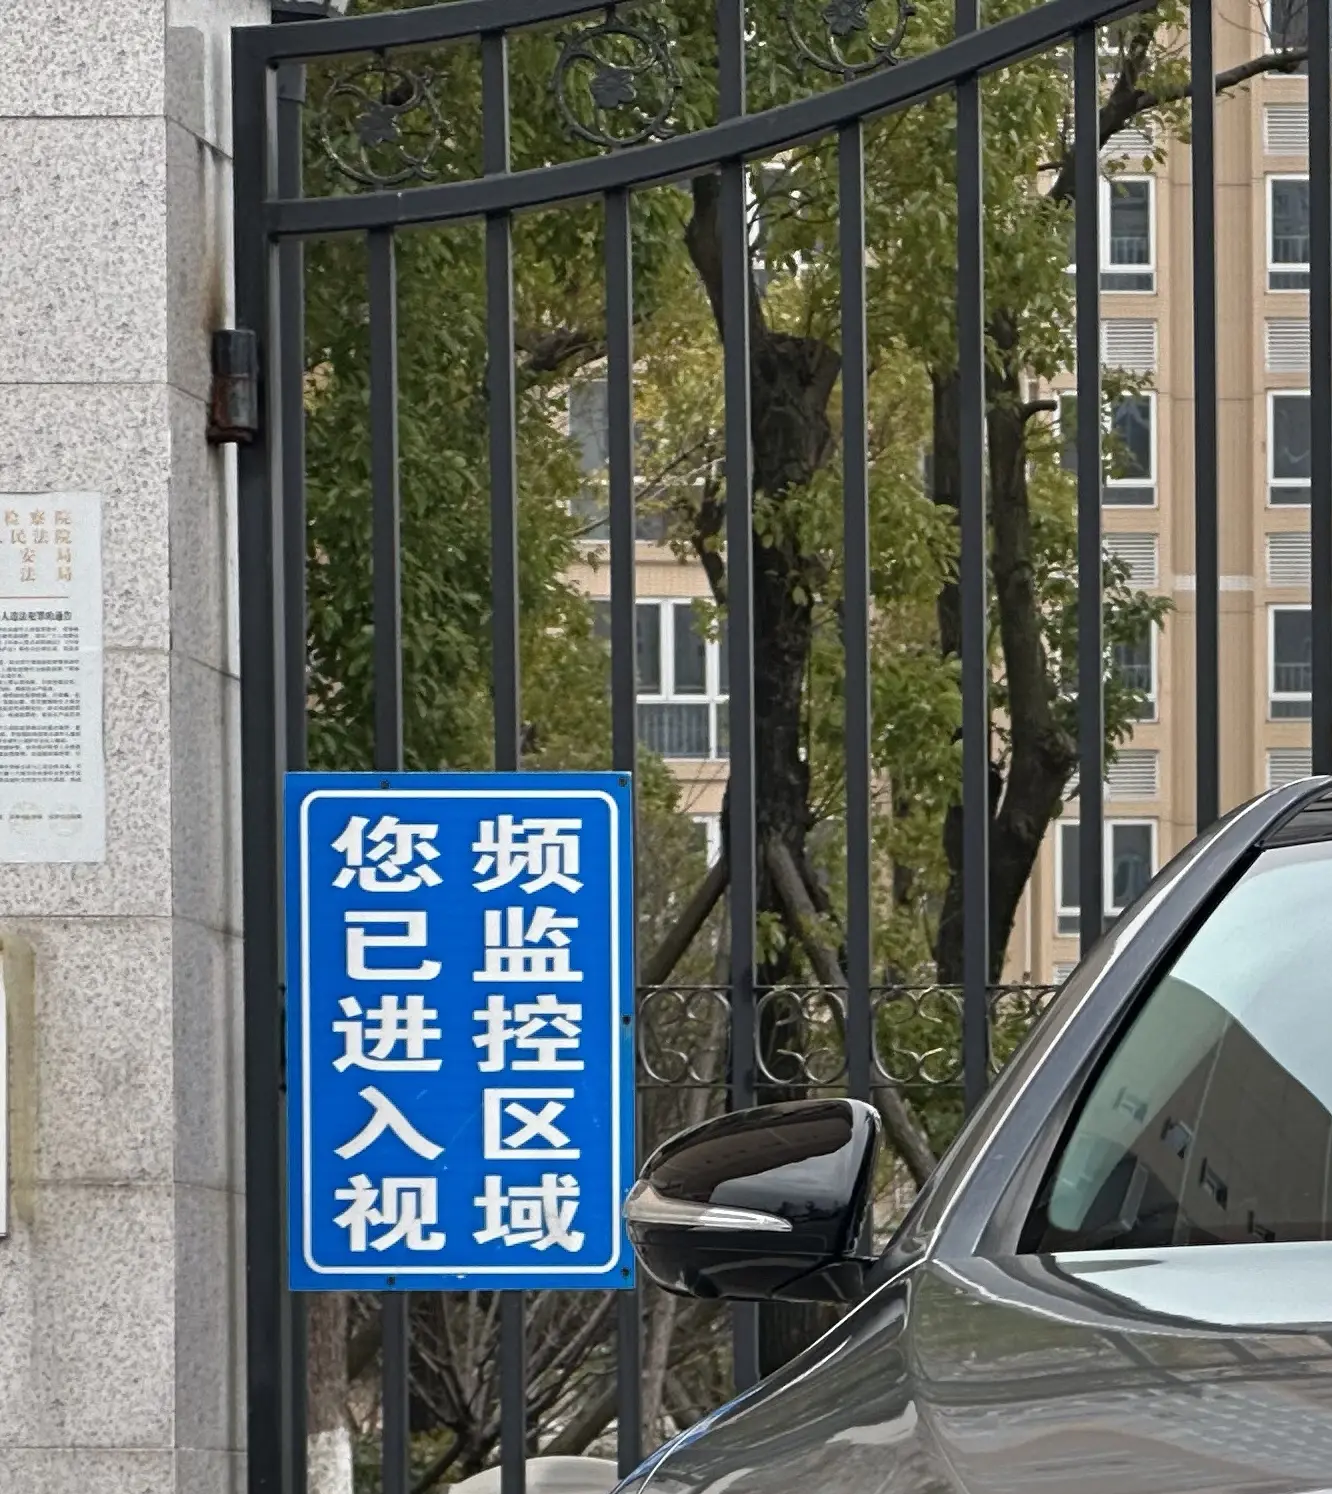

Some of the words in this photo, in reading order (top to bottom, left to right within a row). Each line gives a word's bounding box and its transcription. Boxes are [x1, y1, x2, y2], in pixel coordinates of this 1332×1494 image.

[332, 815, 447, 1252] 您已进入视
[472, 814, 585, 1253] 频监控区域
